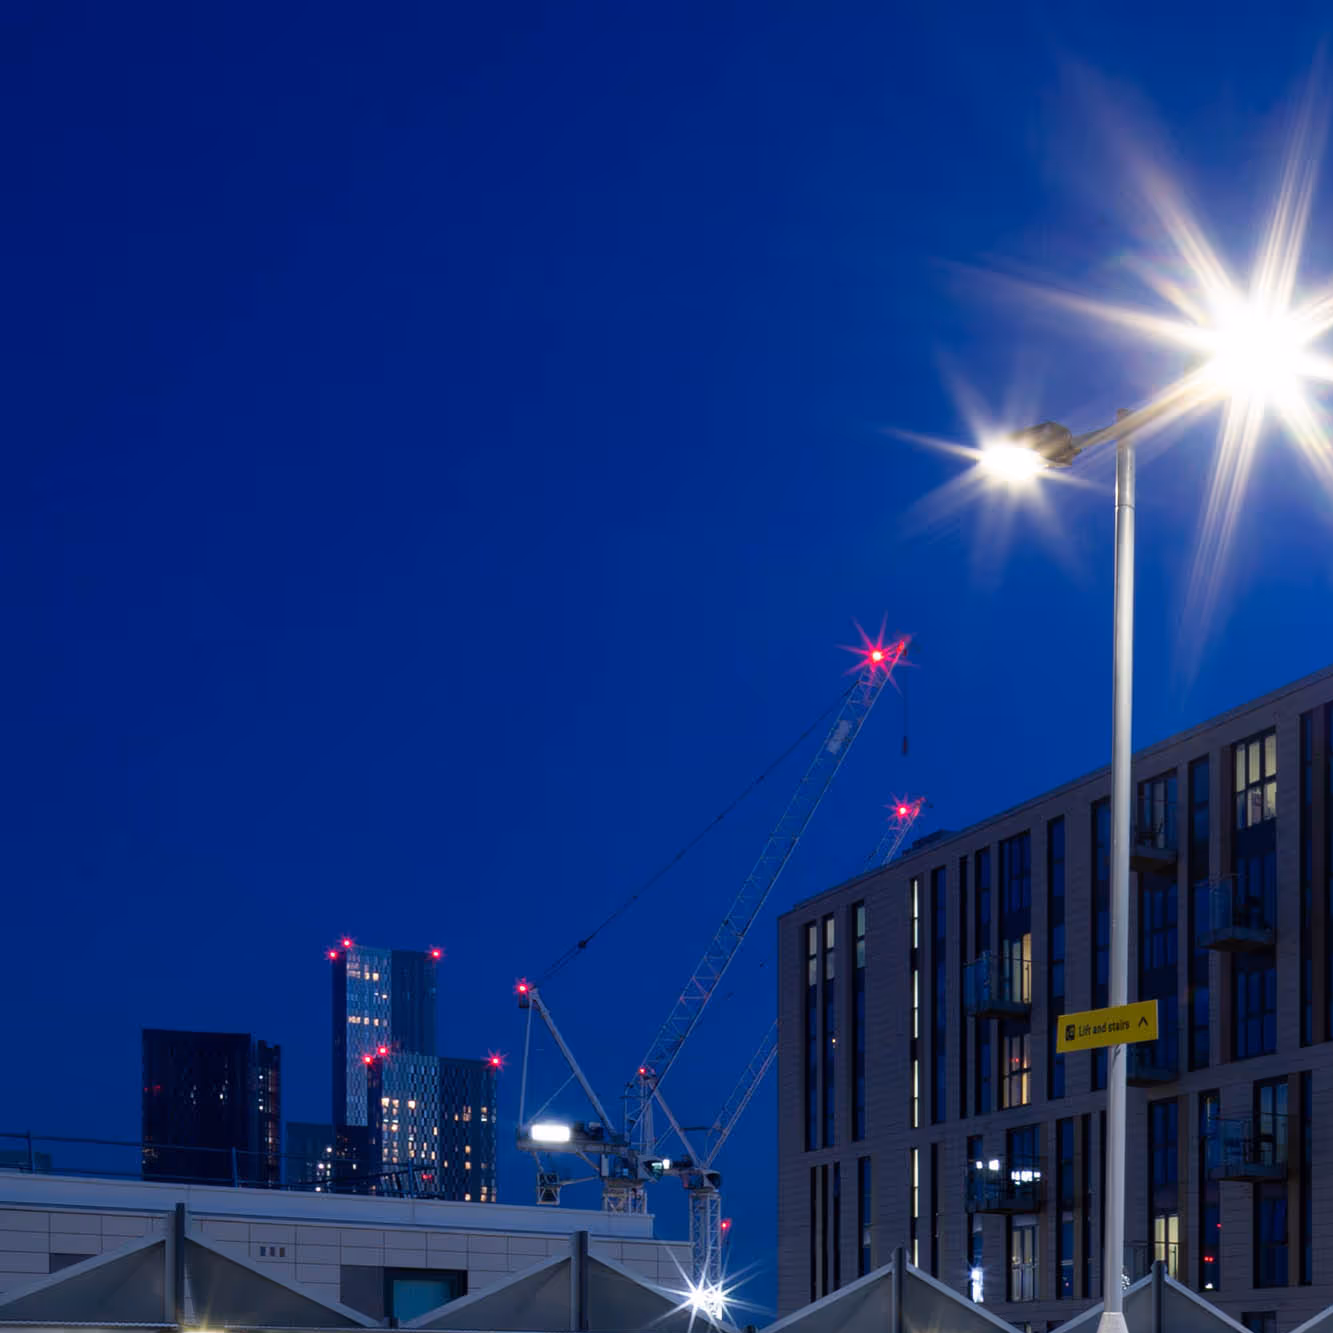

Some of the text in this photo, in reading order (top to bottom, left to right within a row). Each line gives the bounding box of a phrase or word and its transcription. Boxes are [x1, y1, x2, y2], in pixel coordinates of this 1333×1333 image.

[1078, 1019, 1130, 1037] Lift and stairs
